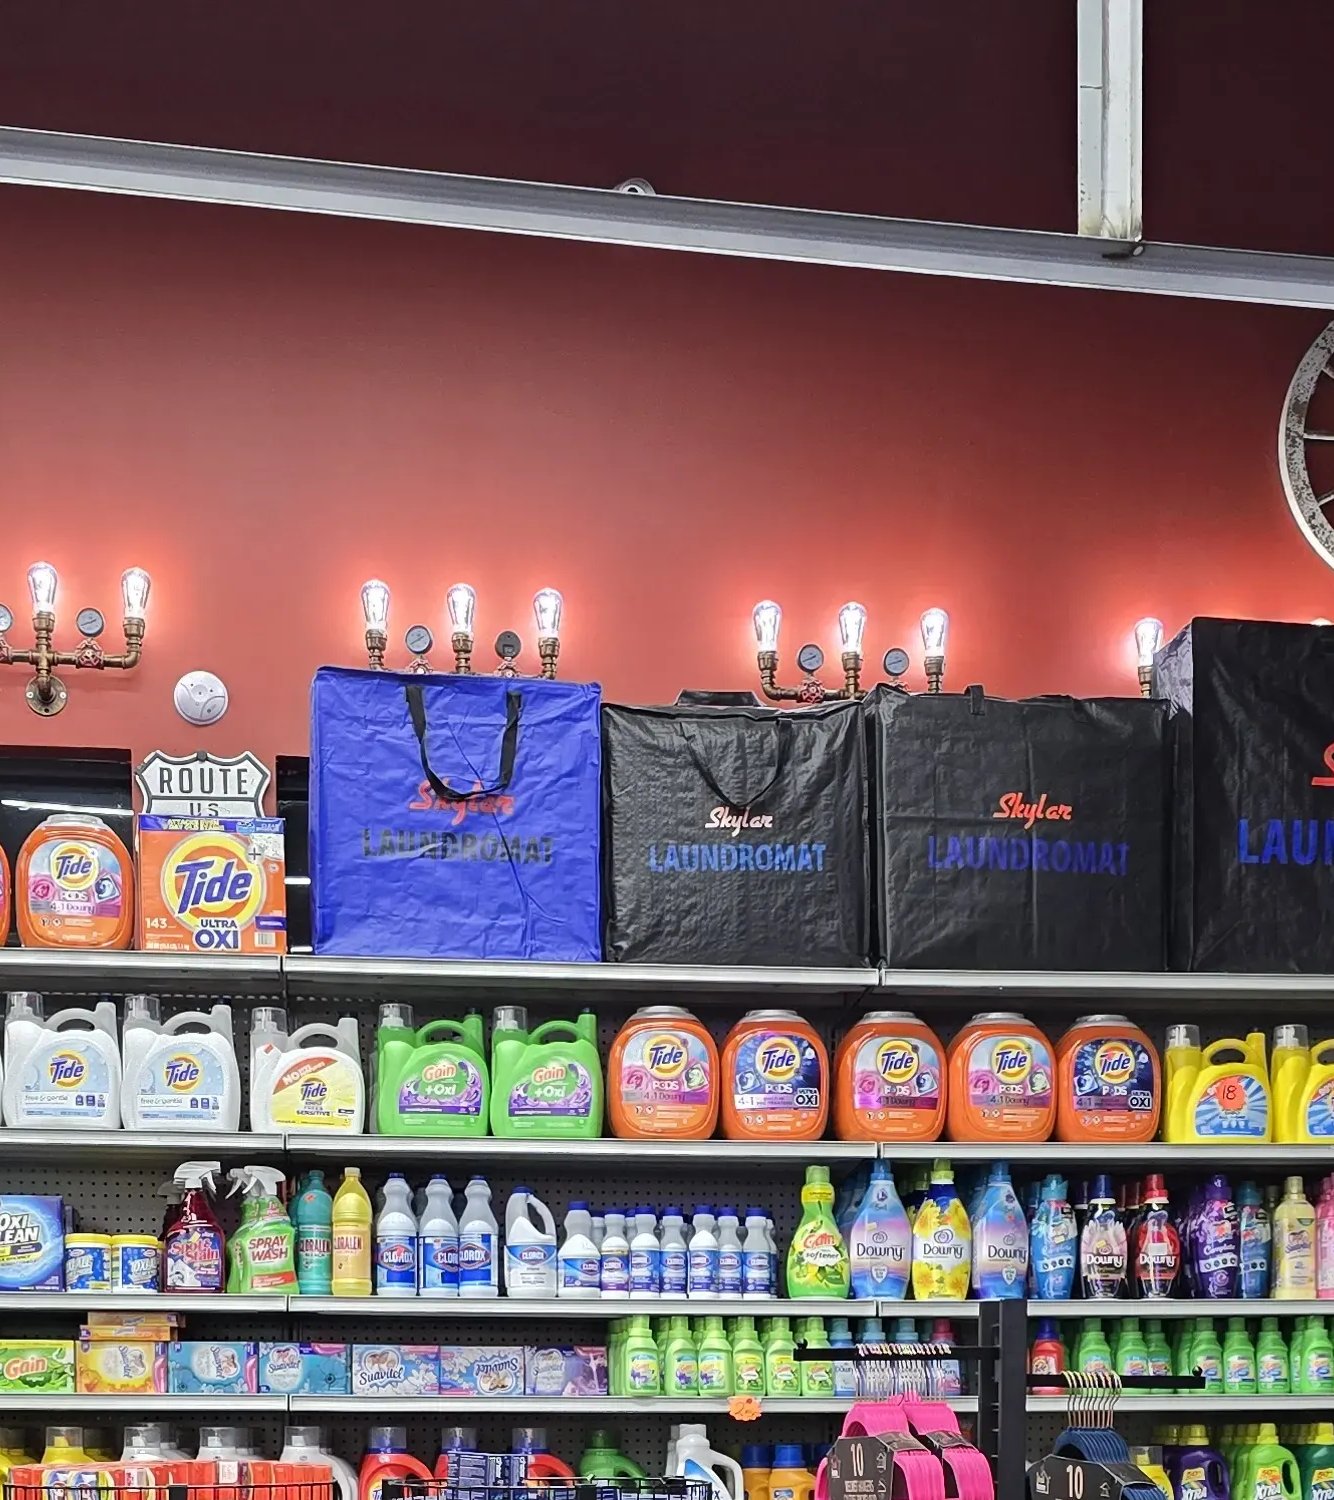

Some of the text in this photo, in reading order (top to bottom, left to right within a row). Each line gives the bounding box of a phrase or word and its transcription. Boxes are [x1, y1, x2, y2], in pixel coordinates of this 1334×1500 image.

[159, 767, 248, 794] ROUTE
[408, 779, 513, 826] Skylar
[992, 793, 1072, 830] Skylar
[704, 806, 774, 837] Skylar
[361, 827, 554, 866] LAUNDROMAT
[927, 833, 1130, 878] LAUNDROMAT
[56, 855, 92, 880] Tide
[648, 841, 826, 874] LAUNDROMAT
[175, 860, 252, 914] Tide
[146, 918, 167, 928] 143
[201, 919, 237, 928] ULTRA
[195, 930, 239, 948] OXI
[649, 1046, 683, 1069] Tide
[762, 1049, 795, 1072] Tide
[881, 1051, 914, 1074] Tide
[996, 1052, 1027, 1075] Tide
[1099, 1051, 1130, 1074] Tide
[50, 1060, 85, 1083] Tide
[166, 1061, 199, 1087] Tide
[422, 1064, 457, 1082] Gain
[532, 1065, 567, 1083] Gain
[302, 1083, 327, 1100] Tide
[795, 1094, 818, 1106] OXI
[1222, 1085, 1236, 1101] 18
[1130, 1097, 1151, 1108] OXI
[248, 1235, 287, 1250] SPRAY
[856, 1241, 905, 1261] Downy
[924, 1243, 963, 1261] Downy
[251, 1246, 288, 1263] WASH
[521, 1251, 545, 1261] CLOROX
[805, 1252, 840, 1263] softener
[986, 1245, 1028, 1263] Downy
[1085, 1253, 1124, 1269] Downy
[1139, 1253, 1176, 1269] Downy
[4, 1357, 48, 1379] Gain
[359, 1368, 404, 1387] Suavitel
[851, 1443, 864, 1476] 10
[1066, 1465, 1083, 1499] 10
[1255, 1482, 1282, 1500] XTRA
